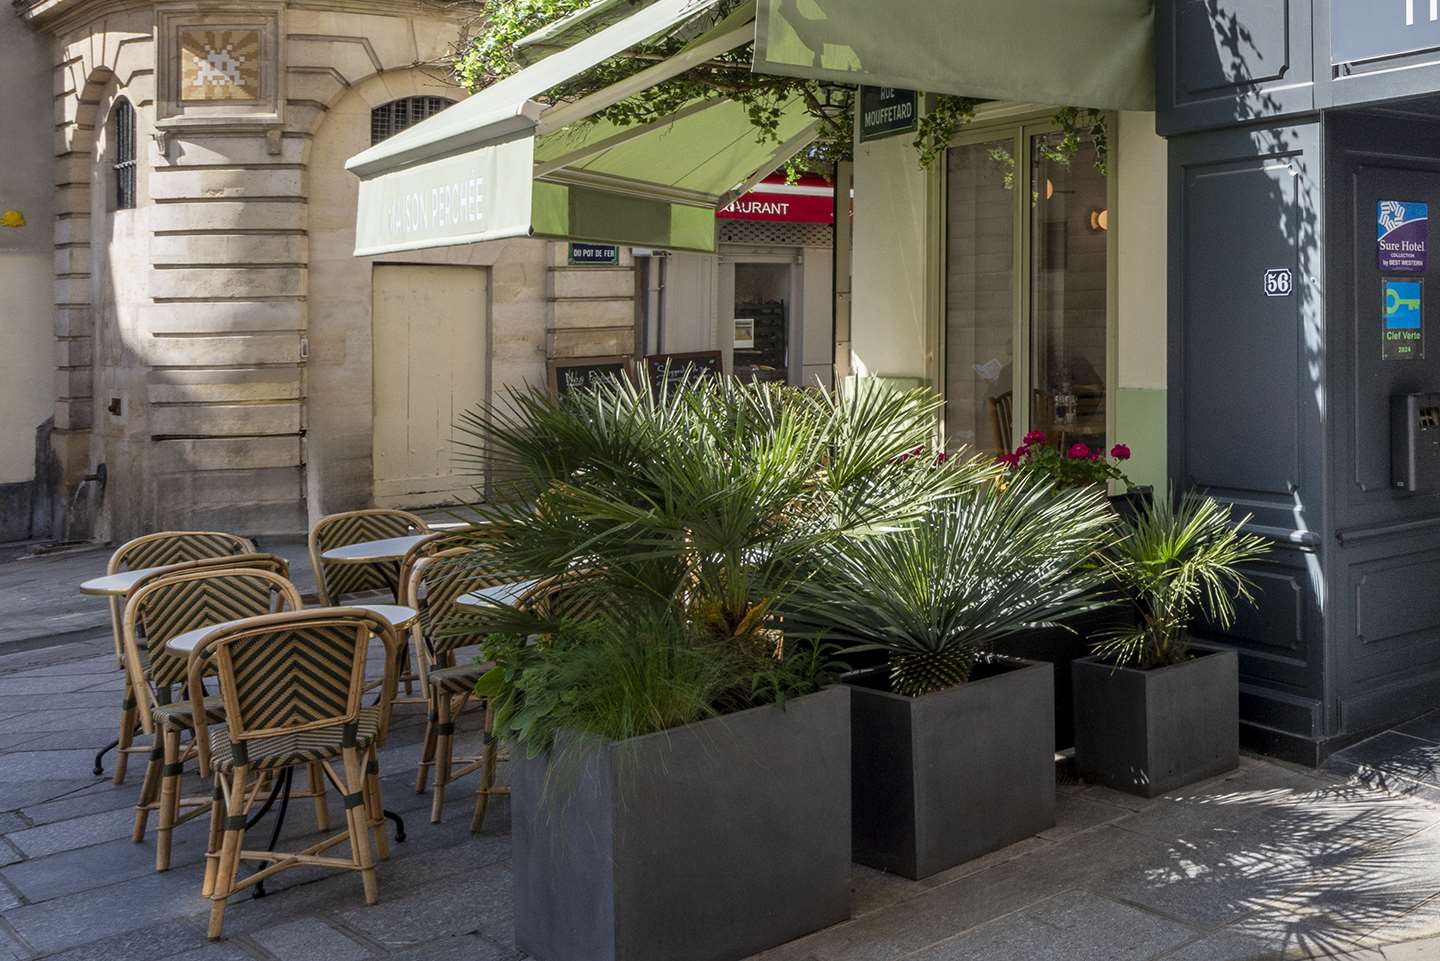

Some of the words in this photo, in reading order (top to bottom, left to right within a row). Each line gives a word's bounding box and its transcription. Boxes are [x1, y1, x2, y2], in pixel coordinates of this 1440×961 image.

[881, 87, 895, 100] RUE
[865, 102, 912, 128] MOUFFETARD
[1380, 240, 1400, 250] Sure
[1402, 241, 1424, 251] Hotel
[573, 249, 582, 257] DU
[583, 249, 594, 257] POT
[595, 249, 603, 257] DE
[604, 249, 615, 257] FER
[1268, 272, 1288, 292] 56
